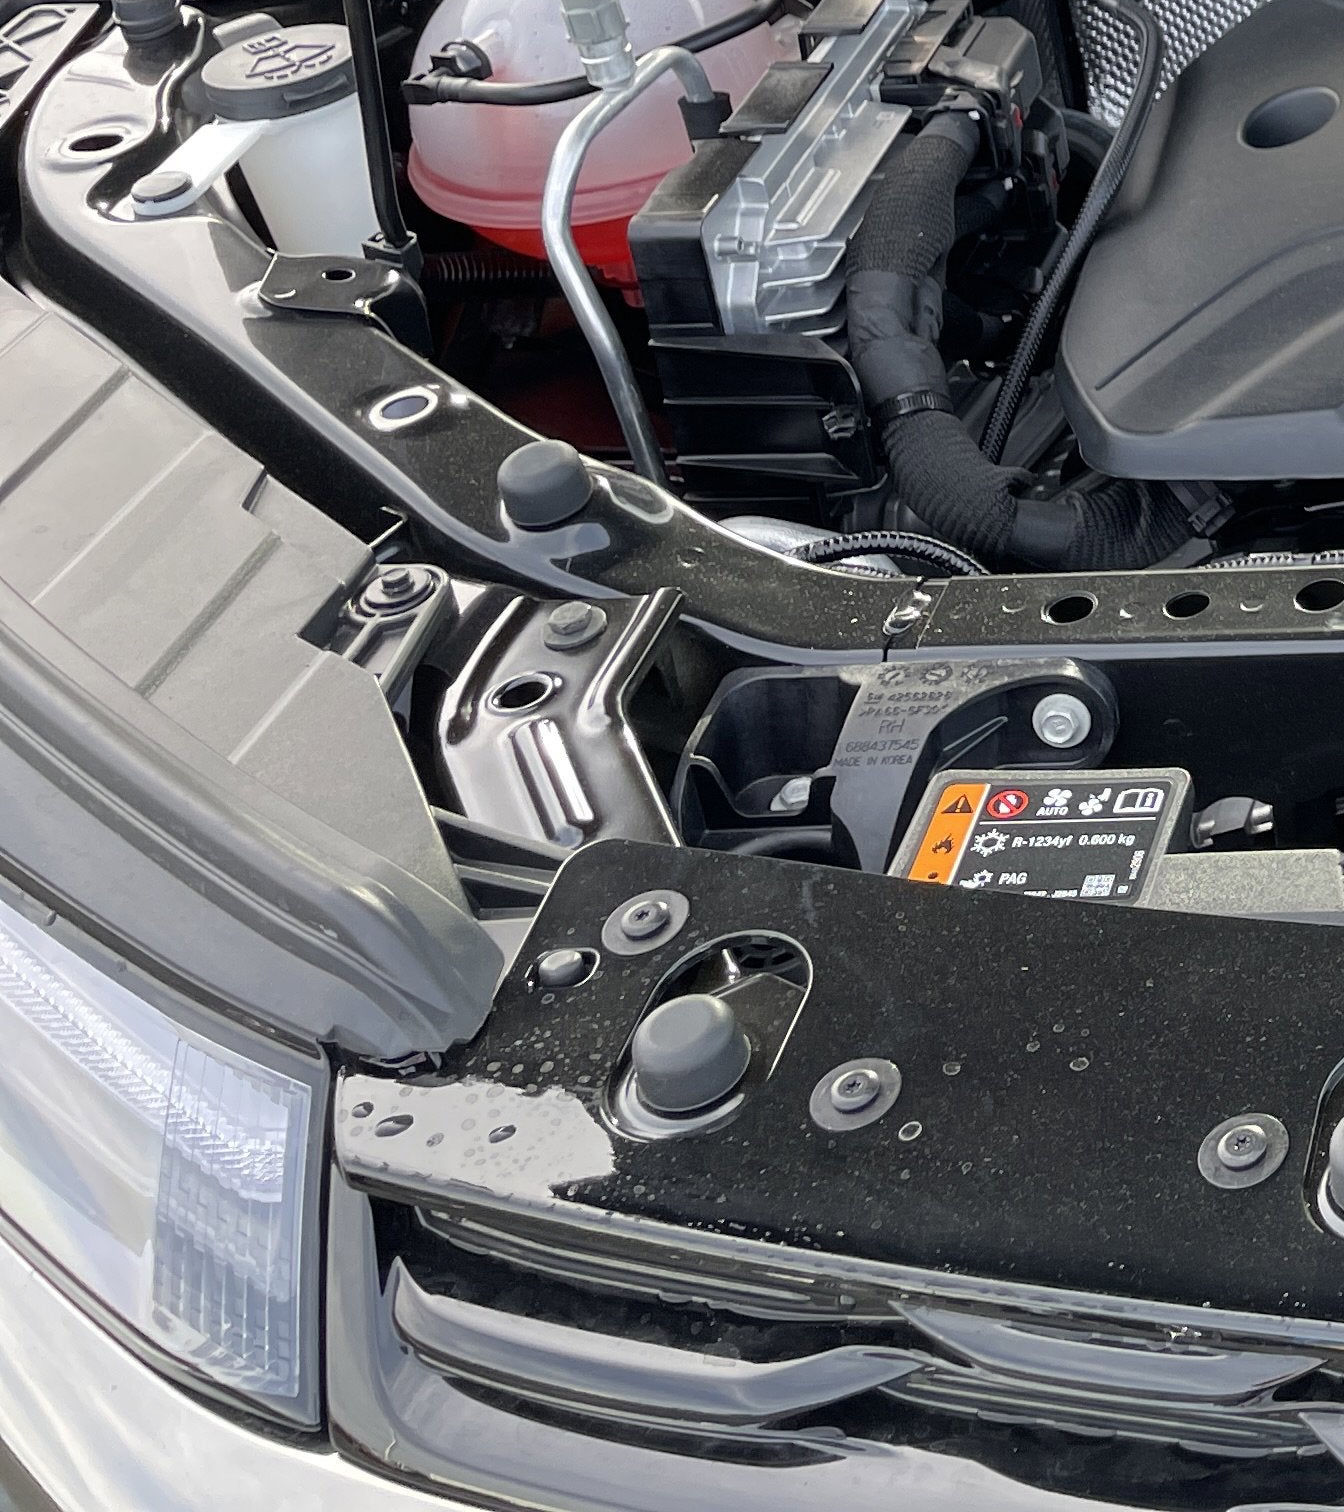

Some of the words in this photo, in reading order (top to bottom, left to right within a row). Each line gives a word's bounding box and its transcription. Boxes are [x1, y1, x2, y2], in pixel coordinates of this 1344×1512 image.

[878, 718, 906, 734] RH
[834, 757, 860, 767] MADE
[867, 756, 878, 766] IN
[881, 754, 913, 766] KOREA
[1035, 806, 1069, 817] AUTO
[1011, 835, 1074, 848] R-1234yf
[1078, 833, 1116, 846] 0.600
[1117, 833, 1136, 846] kg
[998, 872, 1028, 885] PAG
